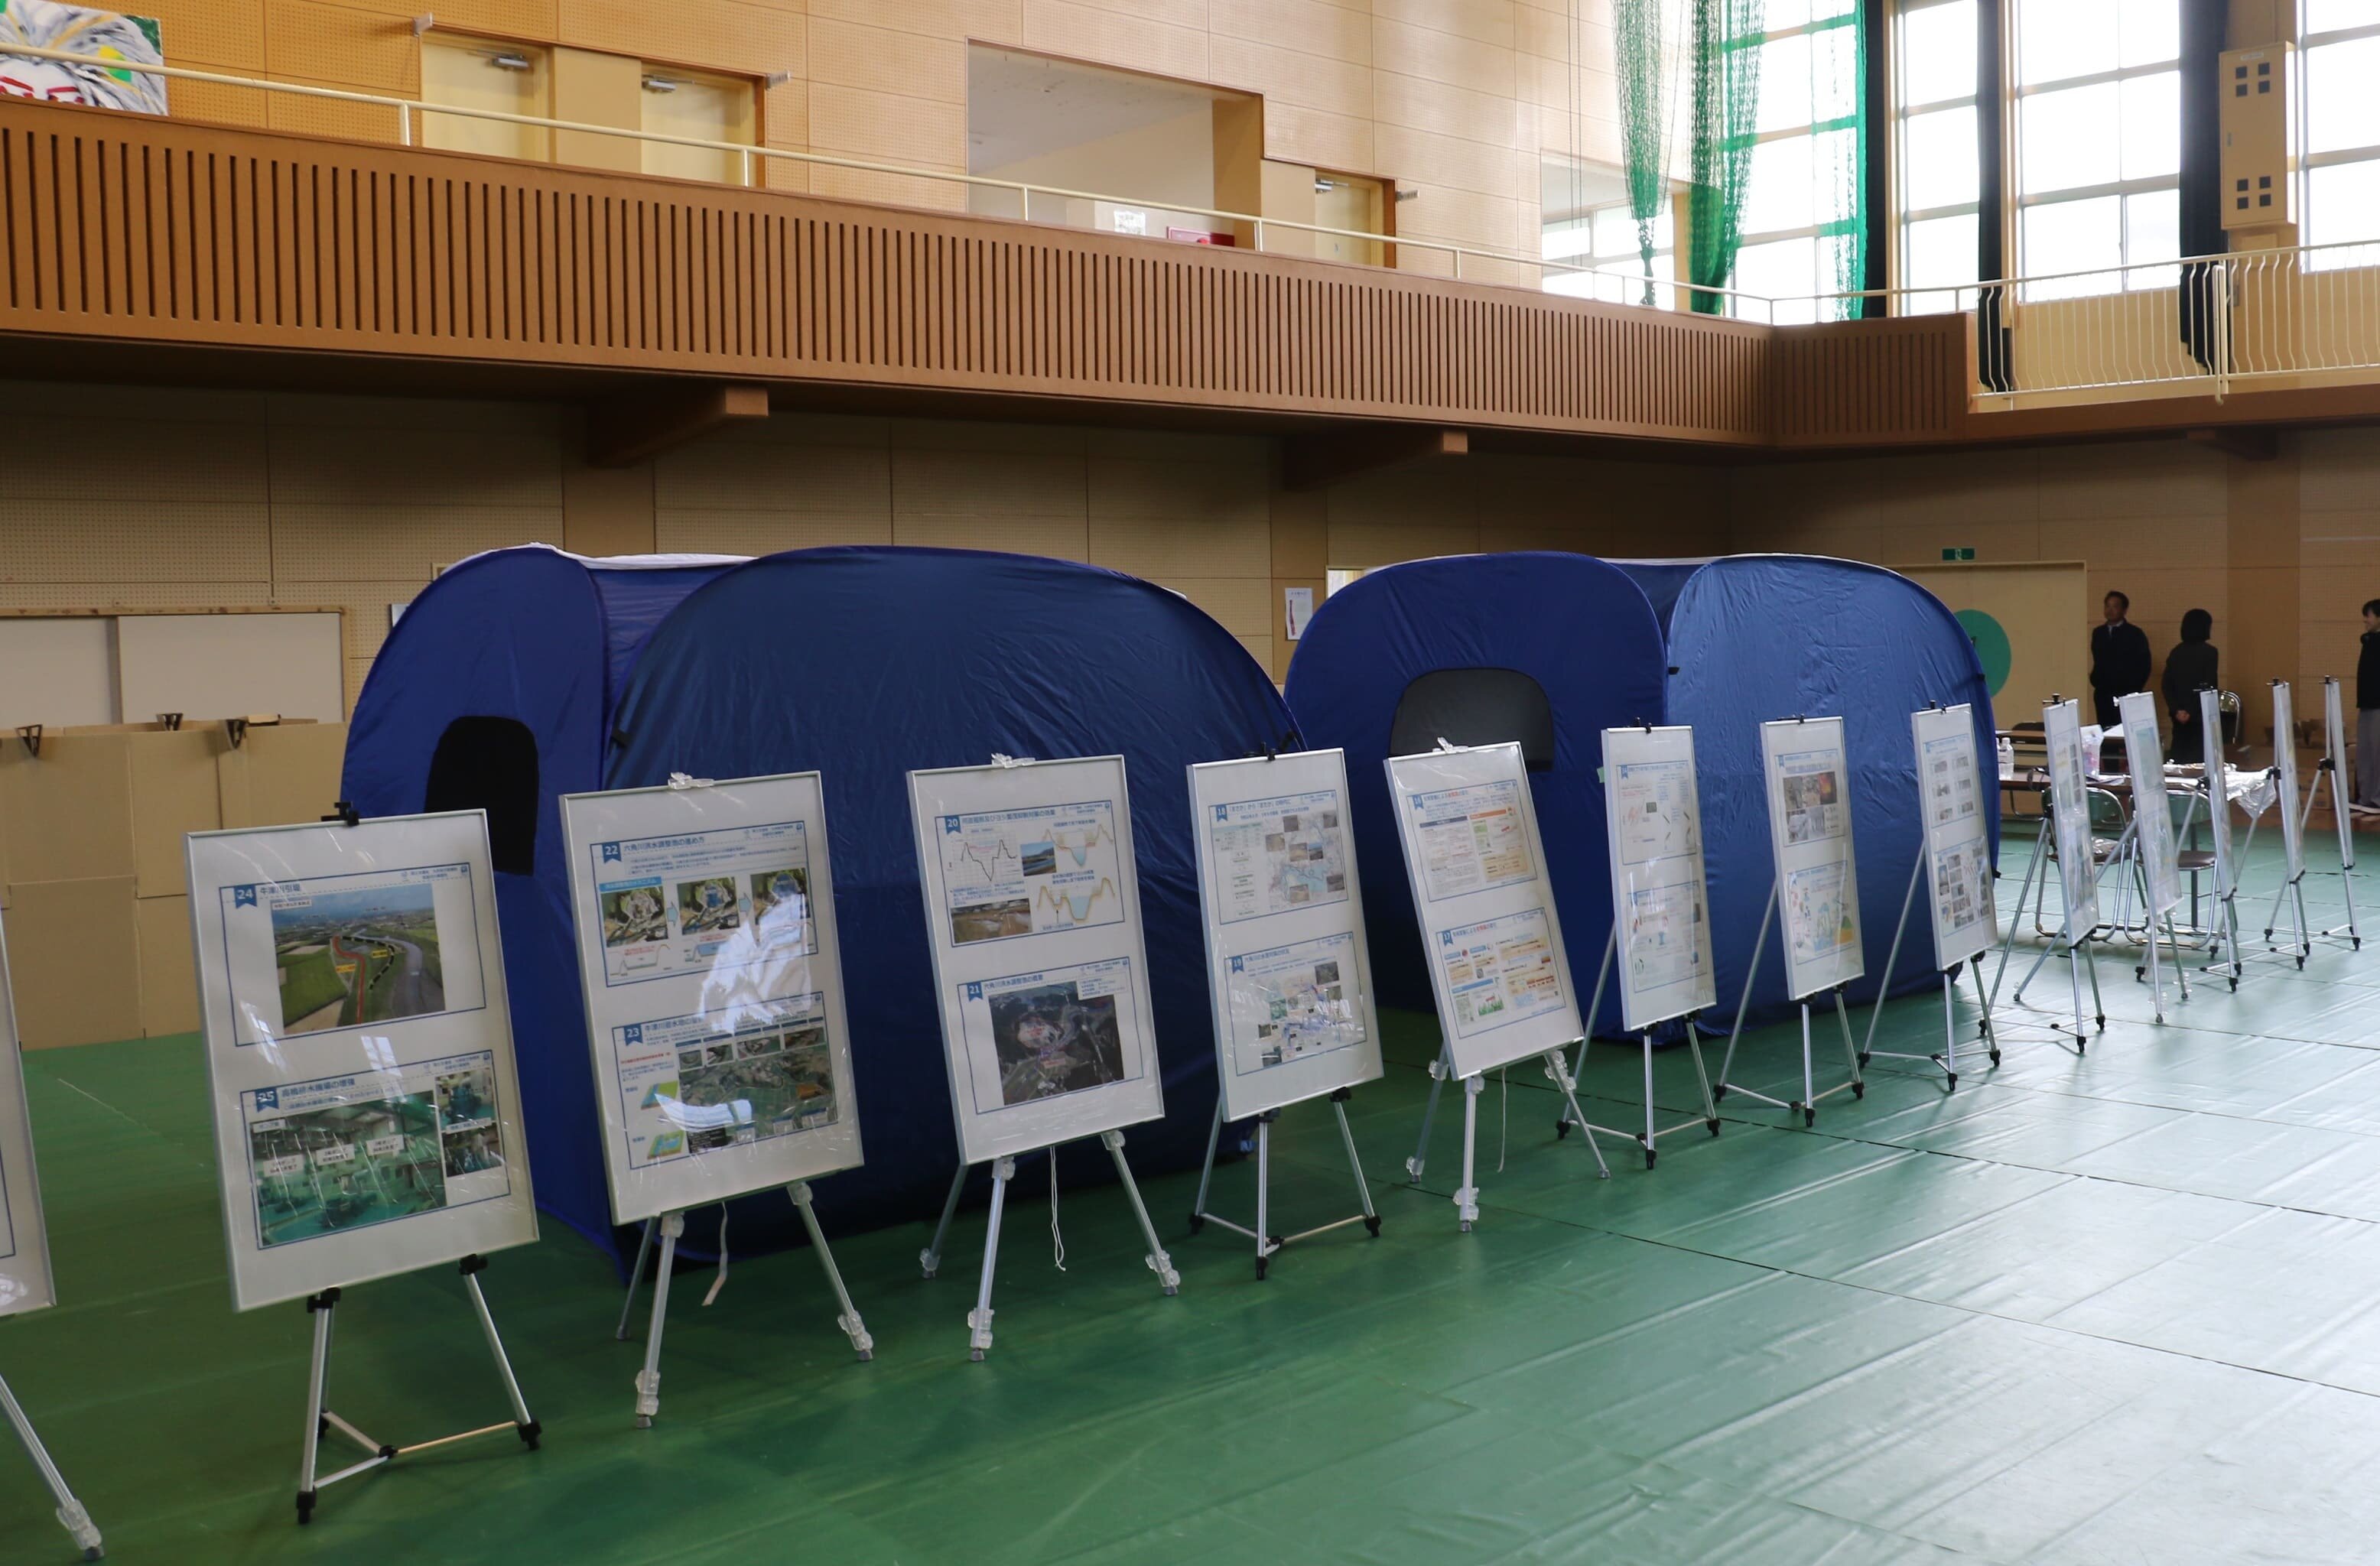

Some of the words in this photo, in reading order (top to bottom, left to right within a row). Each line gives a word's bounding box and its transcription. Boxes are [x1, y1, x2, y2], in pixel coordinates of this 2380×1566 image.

[947, 819, 958, 829] 20
[605, 845, 619, 856] 22
[236, 888, 254, 901] 24
[969, 985, 980, 995] 21
[626, 1027, 640, 1038] 23
[258, 1090, 275, 1103] 25
